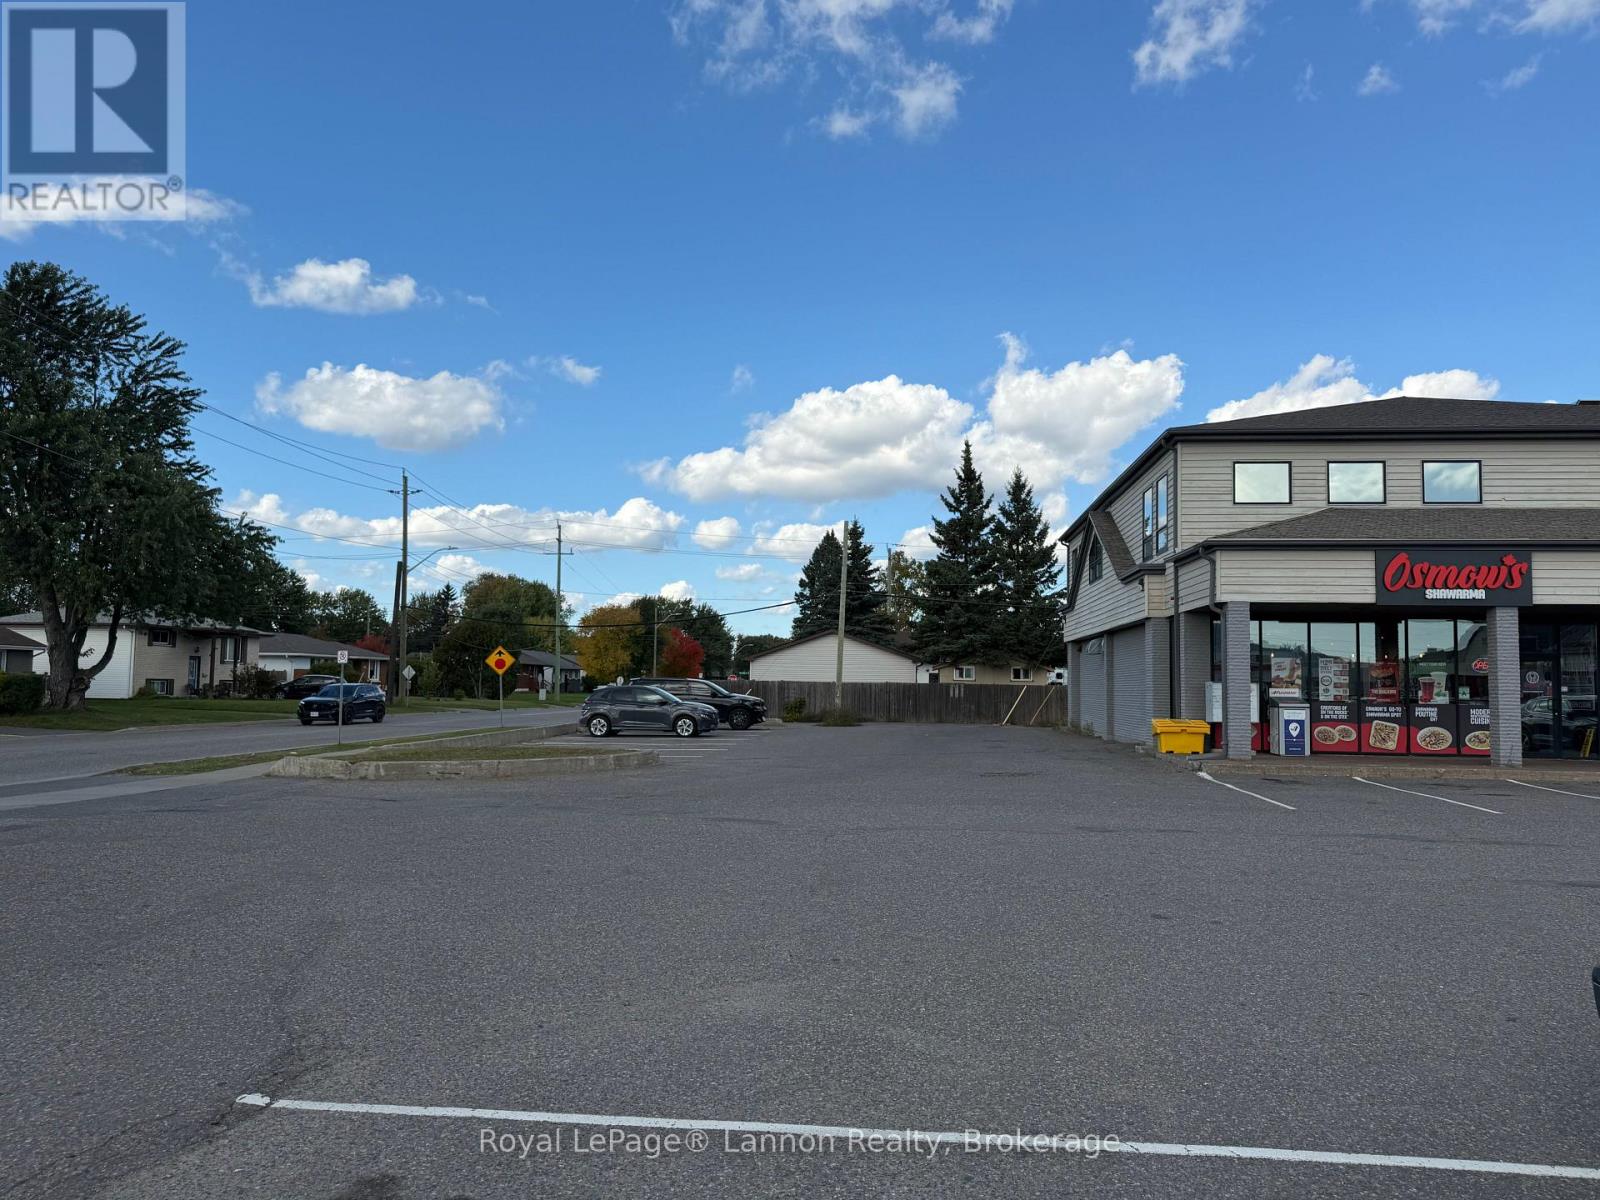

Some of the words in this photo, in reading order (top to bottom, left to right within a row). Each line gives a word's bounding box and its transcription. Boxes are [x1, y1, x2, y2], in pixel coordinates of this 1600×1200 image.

[1384, 552, 1528, 592] Osmow's
[1425, 589, 1486, 600] SHAWARMA
[1470, 717, 1491, 725] CUISIN
